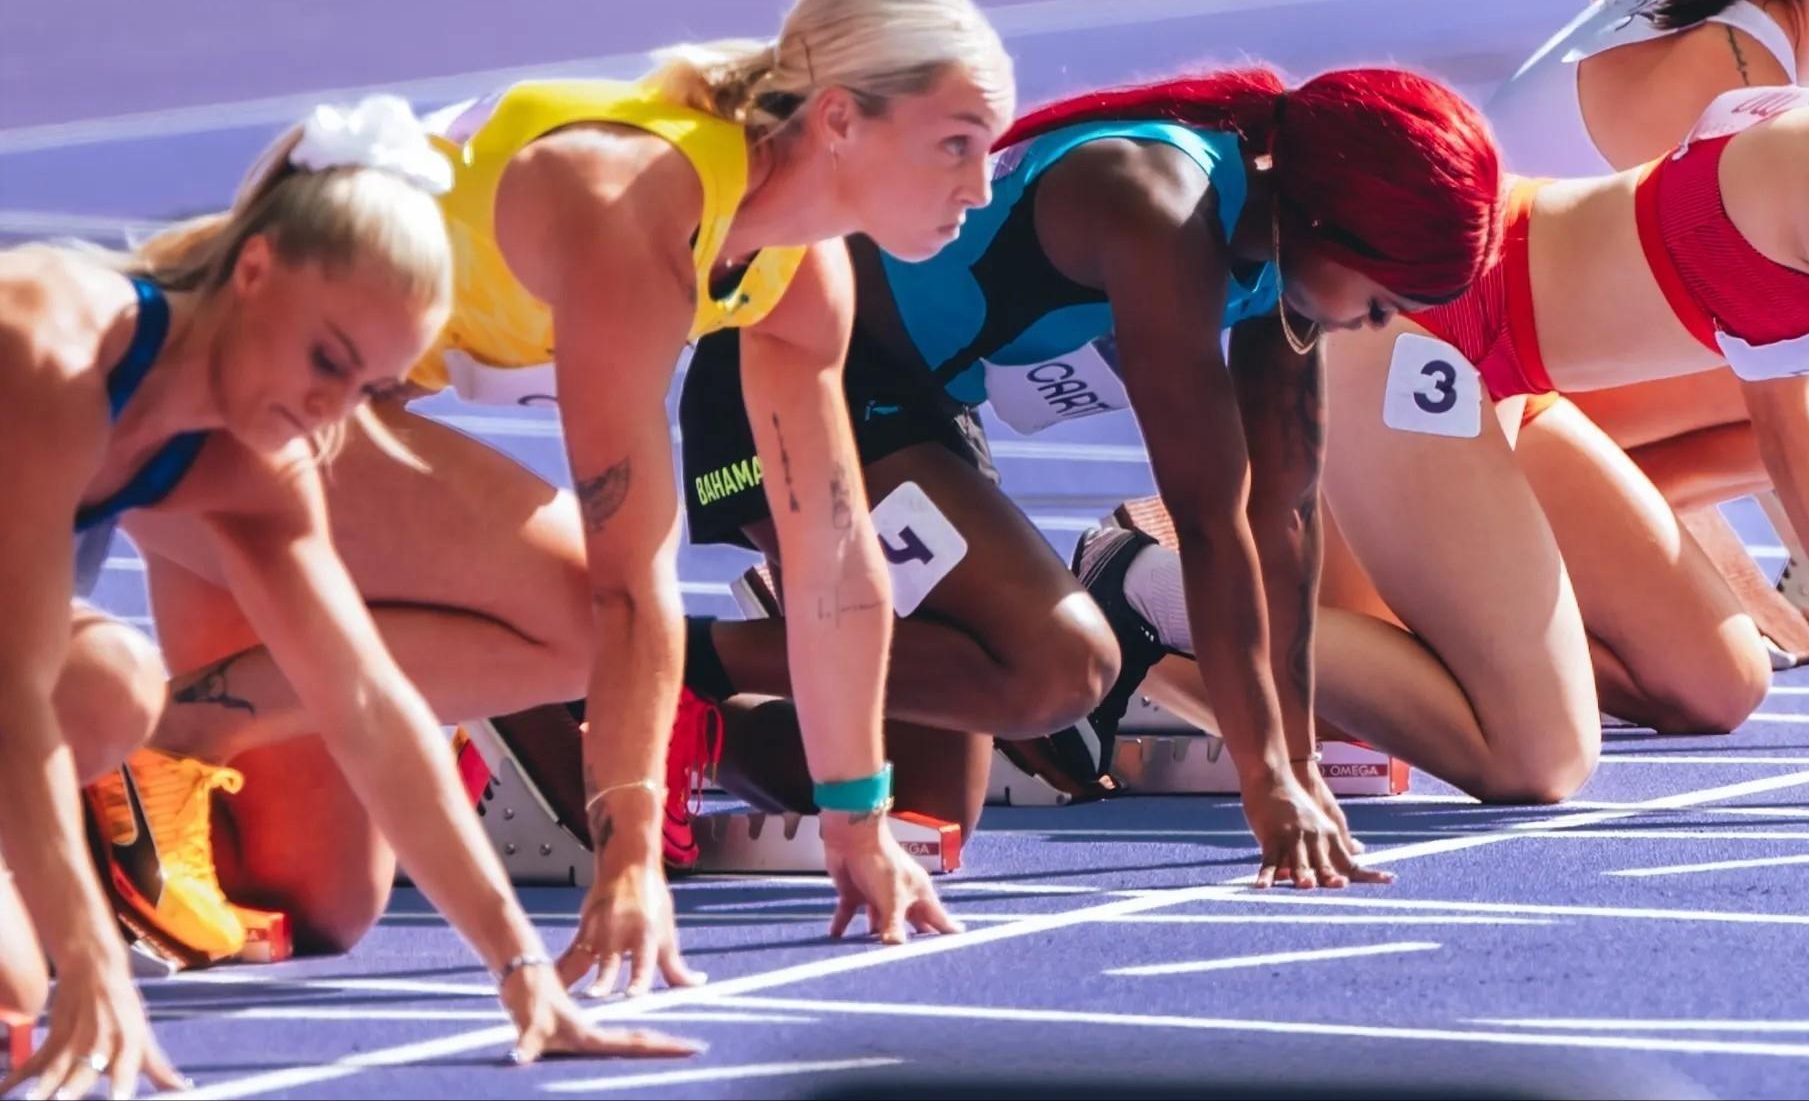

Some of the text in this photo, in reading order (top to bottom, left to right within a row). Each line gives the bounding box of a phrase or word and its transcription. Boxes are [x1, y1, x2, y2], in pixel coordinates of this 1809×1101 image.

[1413, 359, 1457, 414] 3
[695, 455, 764, 506] BAHAMA
[1329, 765, 1379, 776] OMEGA
